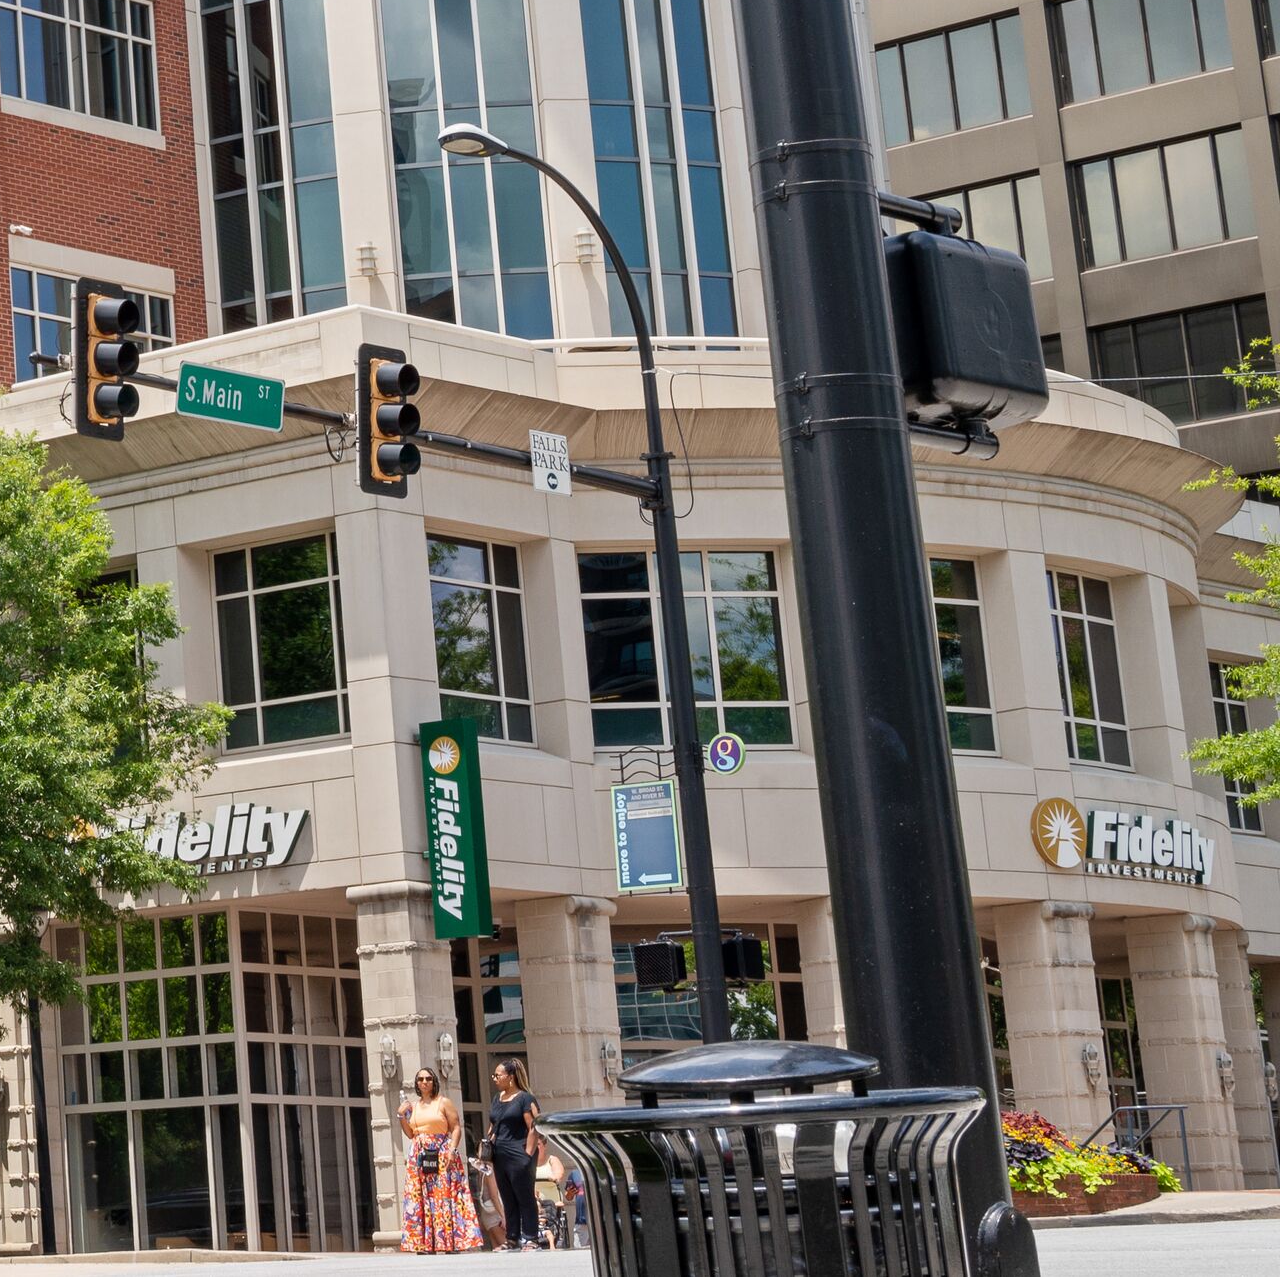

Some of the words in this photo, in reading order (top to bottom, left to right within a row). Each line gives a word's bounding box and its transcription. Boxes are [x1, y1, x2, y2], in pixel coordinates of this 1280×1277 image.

[257, 384, 271, 400] ST
[532, 434, 567, 455] FALLS
[532, 451, 569, 473] PARK
[615, 792, 627, 830] enjoy
[428, 776, 443, 892] INVESTMENTS
[618, 831, 628, 847] to
[1086, 809, 1215, 886] Fidelity
[435, 777, 466, 921] Fidelity
[620, 848, 631, 884] more
[1086, 862, 1197, 885] INVESTMENTS
